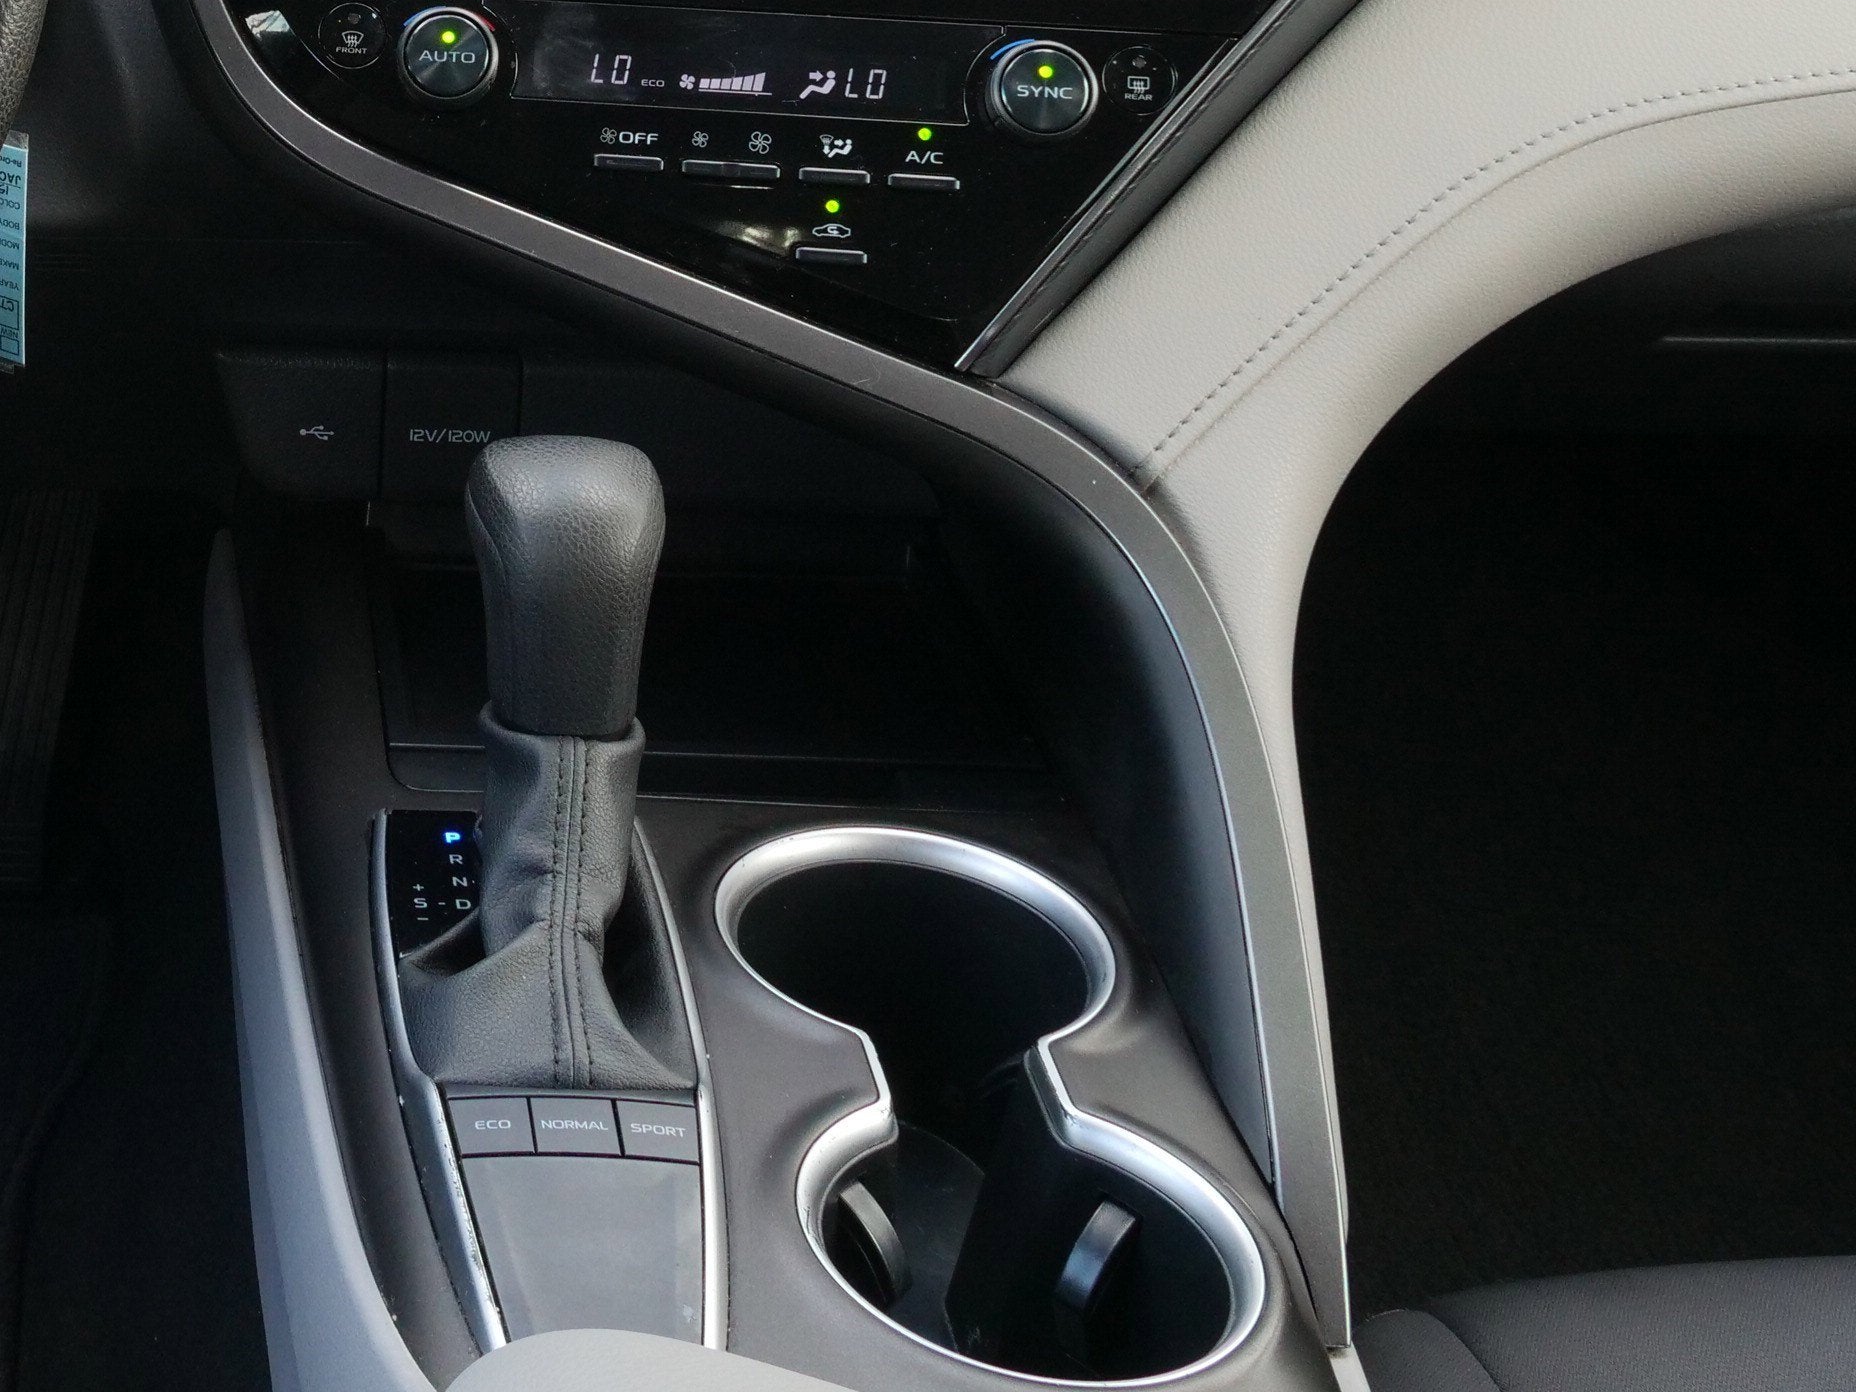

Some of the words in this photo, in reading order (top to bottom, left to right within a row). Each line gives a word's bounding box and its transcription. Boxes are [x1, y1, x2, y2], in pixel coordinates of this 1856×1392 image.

[336, 46, 367, 55] FRONT
[419, 50, 475, 63] AUTO
[591, 53, 632, 84] LO
[641, 78, 665, 88] ECO
[845, 68, 887, 100] LO
[1017, 85, 1073, 100] SYNC
[1124, 92, 1153, 102] REAR
[619, 131, 659, 145] OFF
[905, 151, 944, 165] A/C
[409, 428, 490, 443] 12V/120W
[445, 832, 461, 843] P
[449, 854, 463, 864] R
[452, 877, 468, 887] N
[413, 898, 428, 908] S
[455, 899, 471, 909] D
[474, 1119, 511, 1130] ECO
[541, 1119, 608, 1131] NORMAL
[630, 1123, 685, 1137] SPORT
